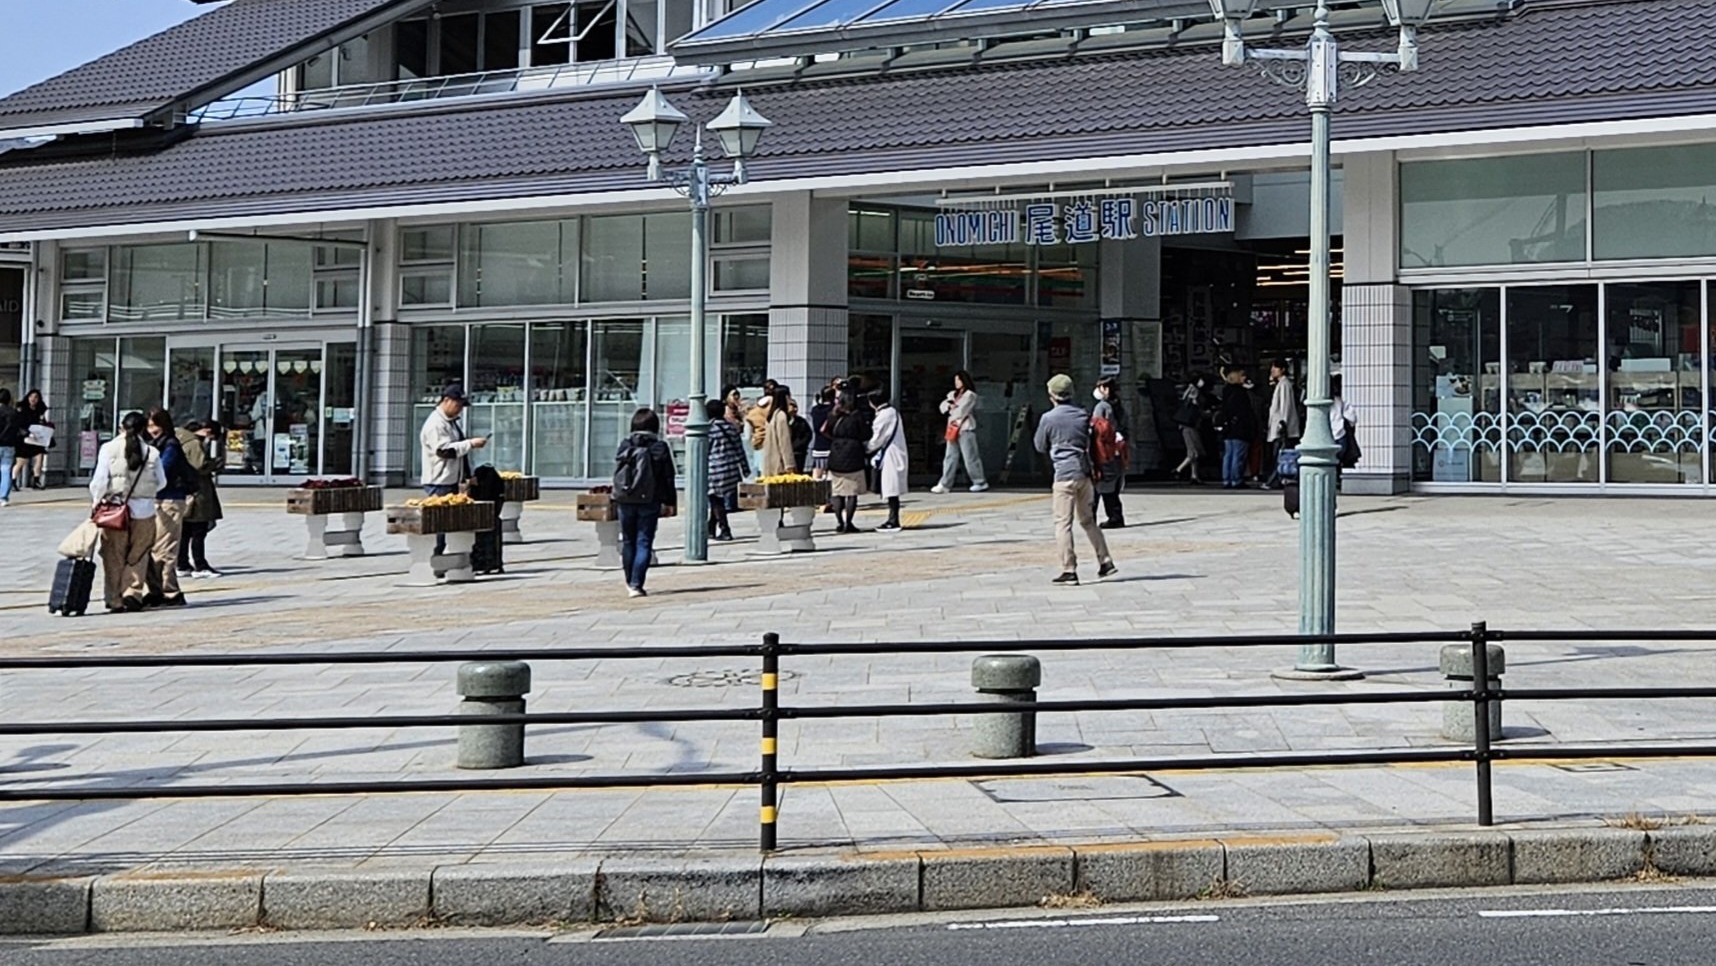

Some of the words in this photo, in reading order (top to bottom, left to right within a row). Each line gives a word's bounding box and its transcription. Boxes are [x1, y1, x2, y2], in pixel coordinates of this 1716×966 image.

[935, 209, 1018, 247] ONOMICHI
[1025, 198, 1137, 246] 尾道駅
[1143, 197, 1235, 236] STATION
